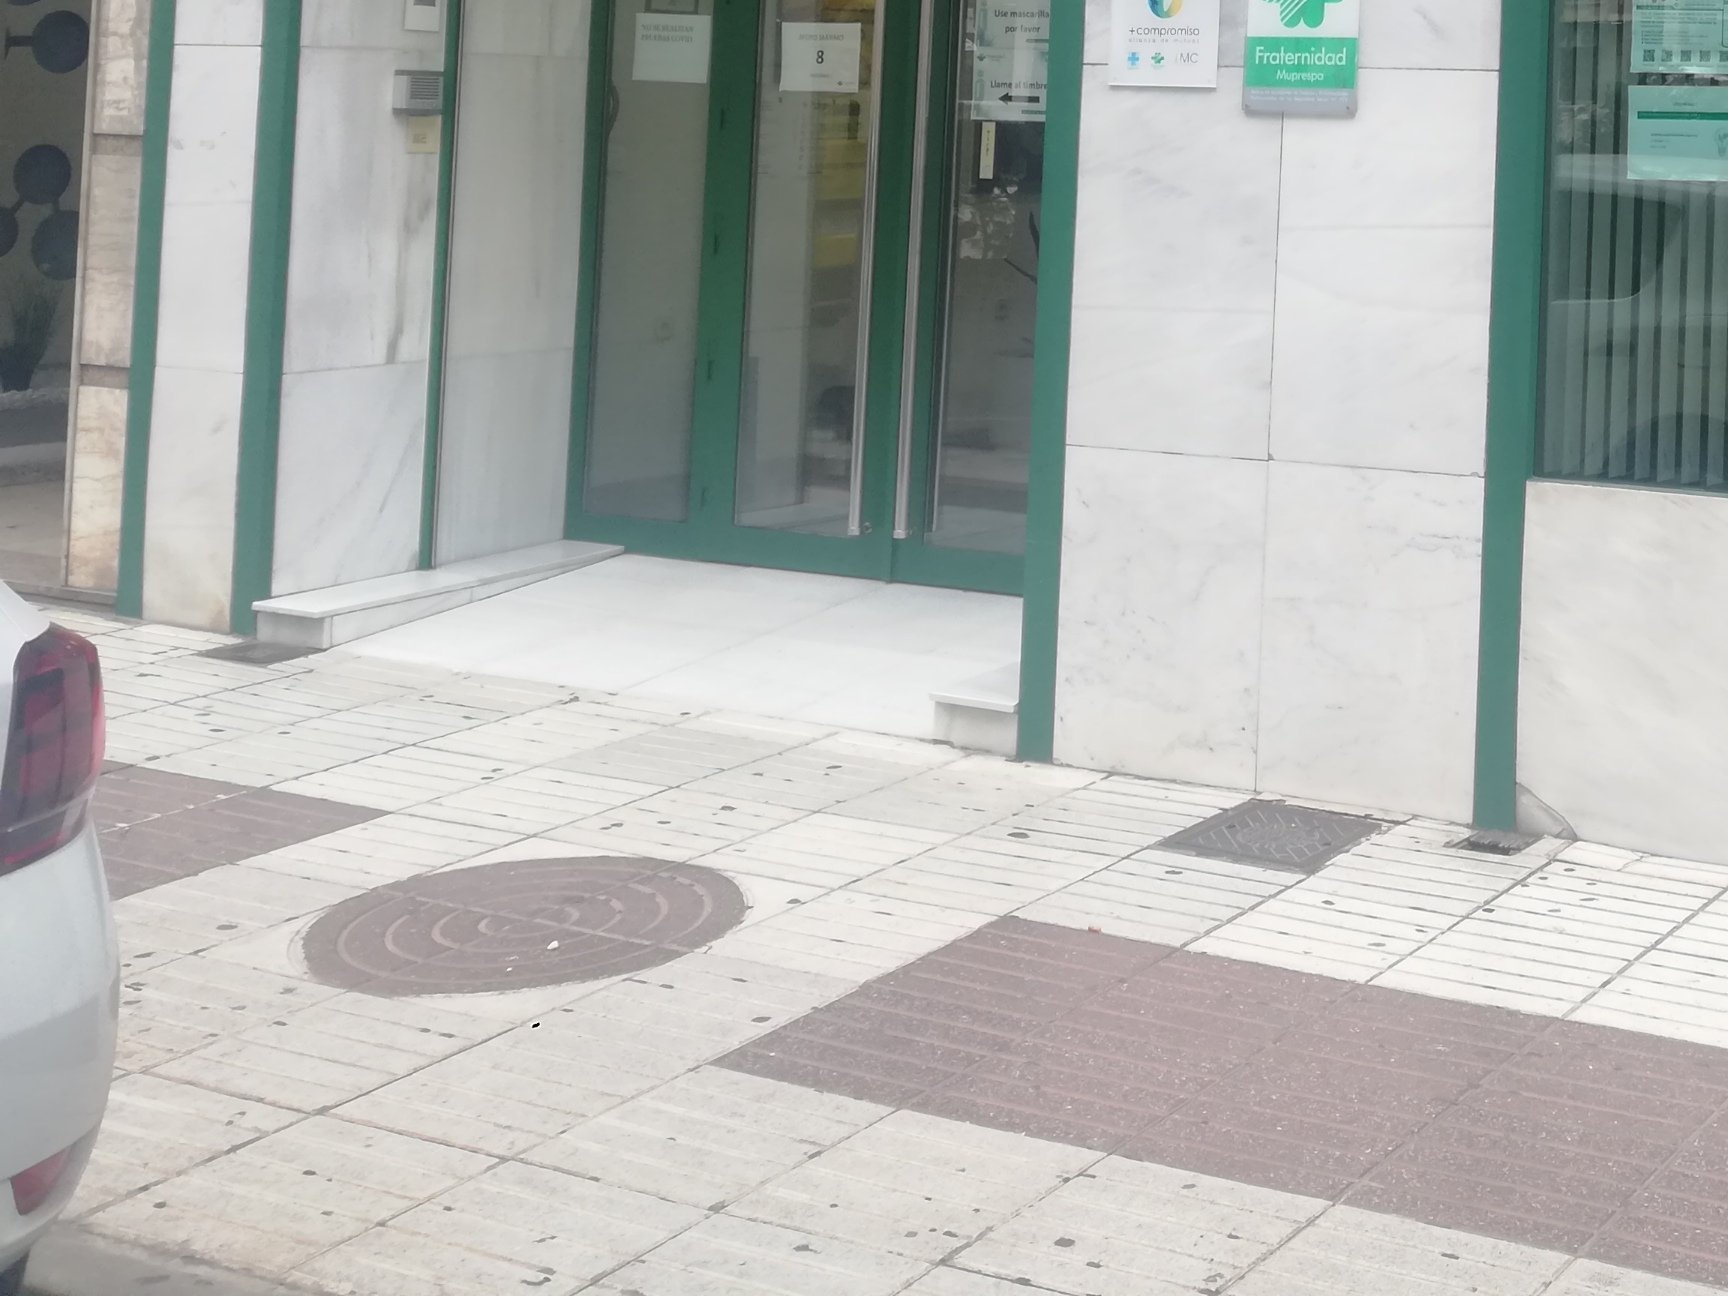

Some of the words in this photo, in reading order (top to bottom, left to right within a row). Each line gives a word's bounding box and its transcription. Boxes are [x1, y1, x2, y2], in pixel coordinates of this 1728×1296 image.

[994, 9, 1008, 18] Use
[1010, 9, 1050, 19] mascarilla
[1004, 26, 1018, 34] por
[1020, 25, 1041, 33] favor
[815, 50, 825, 64] 8
[1255, 46, 1346, 66] Fraternidad
[1276, 69, 1324, 82] Muprespa
[990, 80, 1013, 89] Llame
